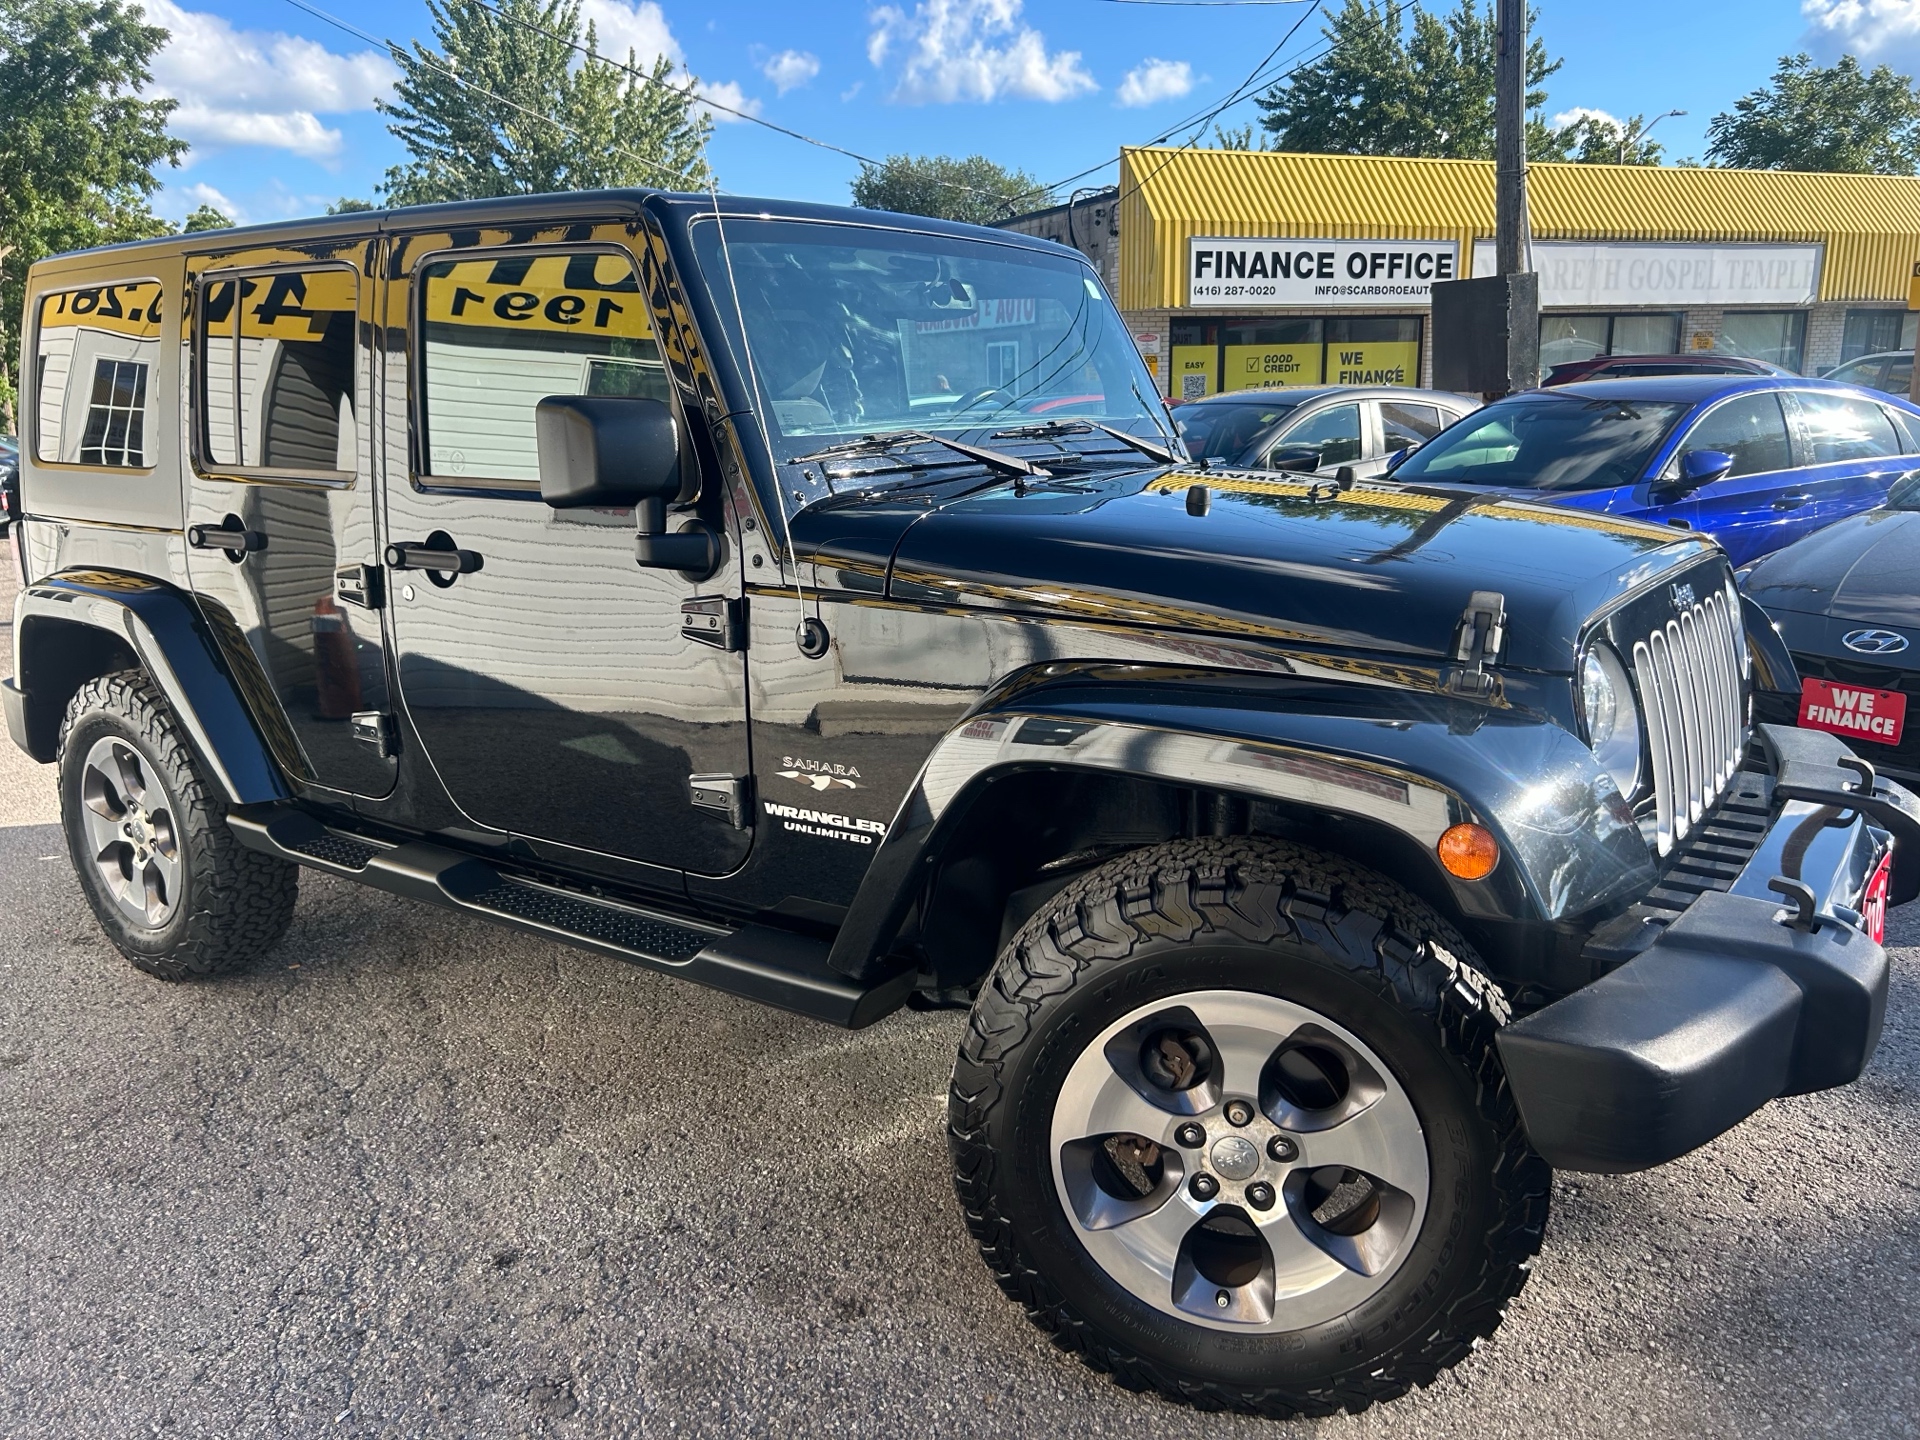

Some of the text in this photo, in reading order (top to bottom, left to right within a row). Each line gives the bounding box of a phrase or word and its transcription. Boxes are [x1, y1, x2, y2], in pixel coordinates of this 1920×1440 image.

[1194, 250, 1453, 280] FINANCE OFFICE
[1627, 258, 1723, 291] GOSPEL
[1193, 286, 1276, 296] (416) 287-0020
[1314, 285, 1432, 296] INFO@SCARBOROEAUT
[1264, 354, 1293, 364] GOOD
[1264, 364, 1300, 373] CREDIT
[1340, 352, 1363, 365] WE
[1339, 370, 1404, 385] FINANCE
[1831, 688, 1875, 713] WE
[1807, 705, 1896, 736] FINANCE
[782, 756, 861, 778] SAHARA
[764, 802, 886, 836] WRANGLER
[783, 821, 872, 845] UNLIMITED
